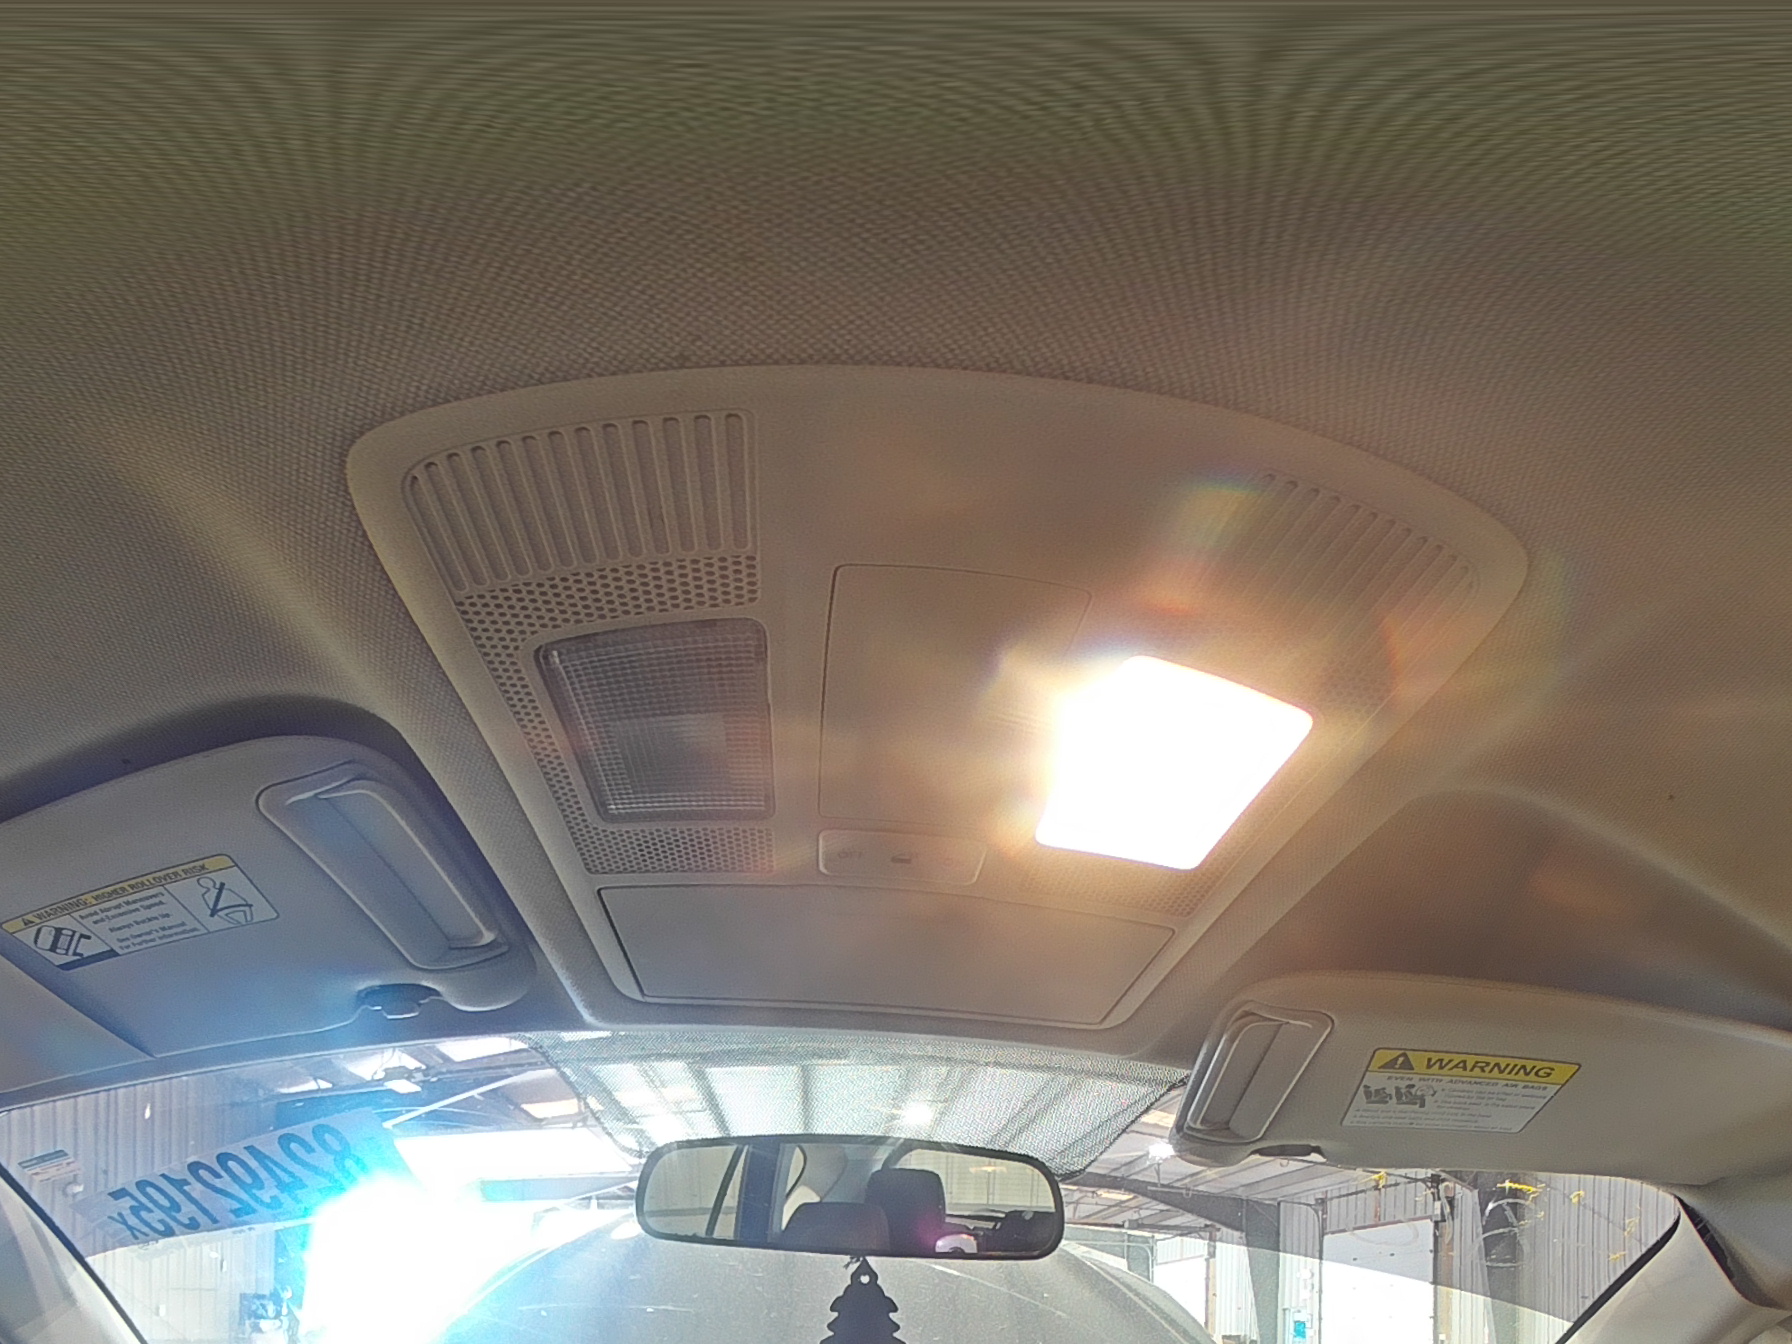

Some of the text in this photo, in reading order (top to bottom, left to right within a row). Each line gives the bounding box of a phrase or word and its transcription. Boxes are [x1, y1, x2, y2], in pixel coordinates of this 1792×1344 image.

[33, 863, 209, 921] WARNING: HIGHER ROLLOVER RISK
[1425, 1056, 1555, 1079] WARNING
[1447, 1078, 1498, 1088] ADVANCED
